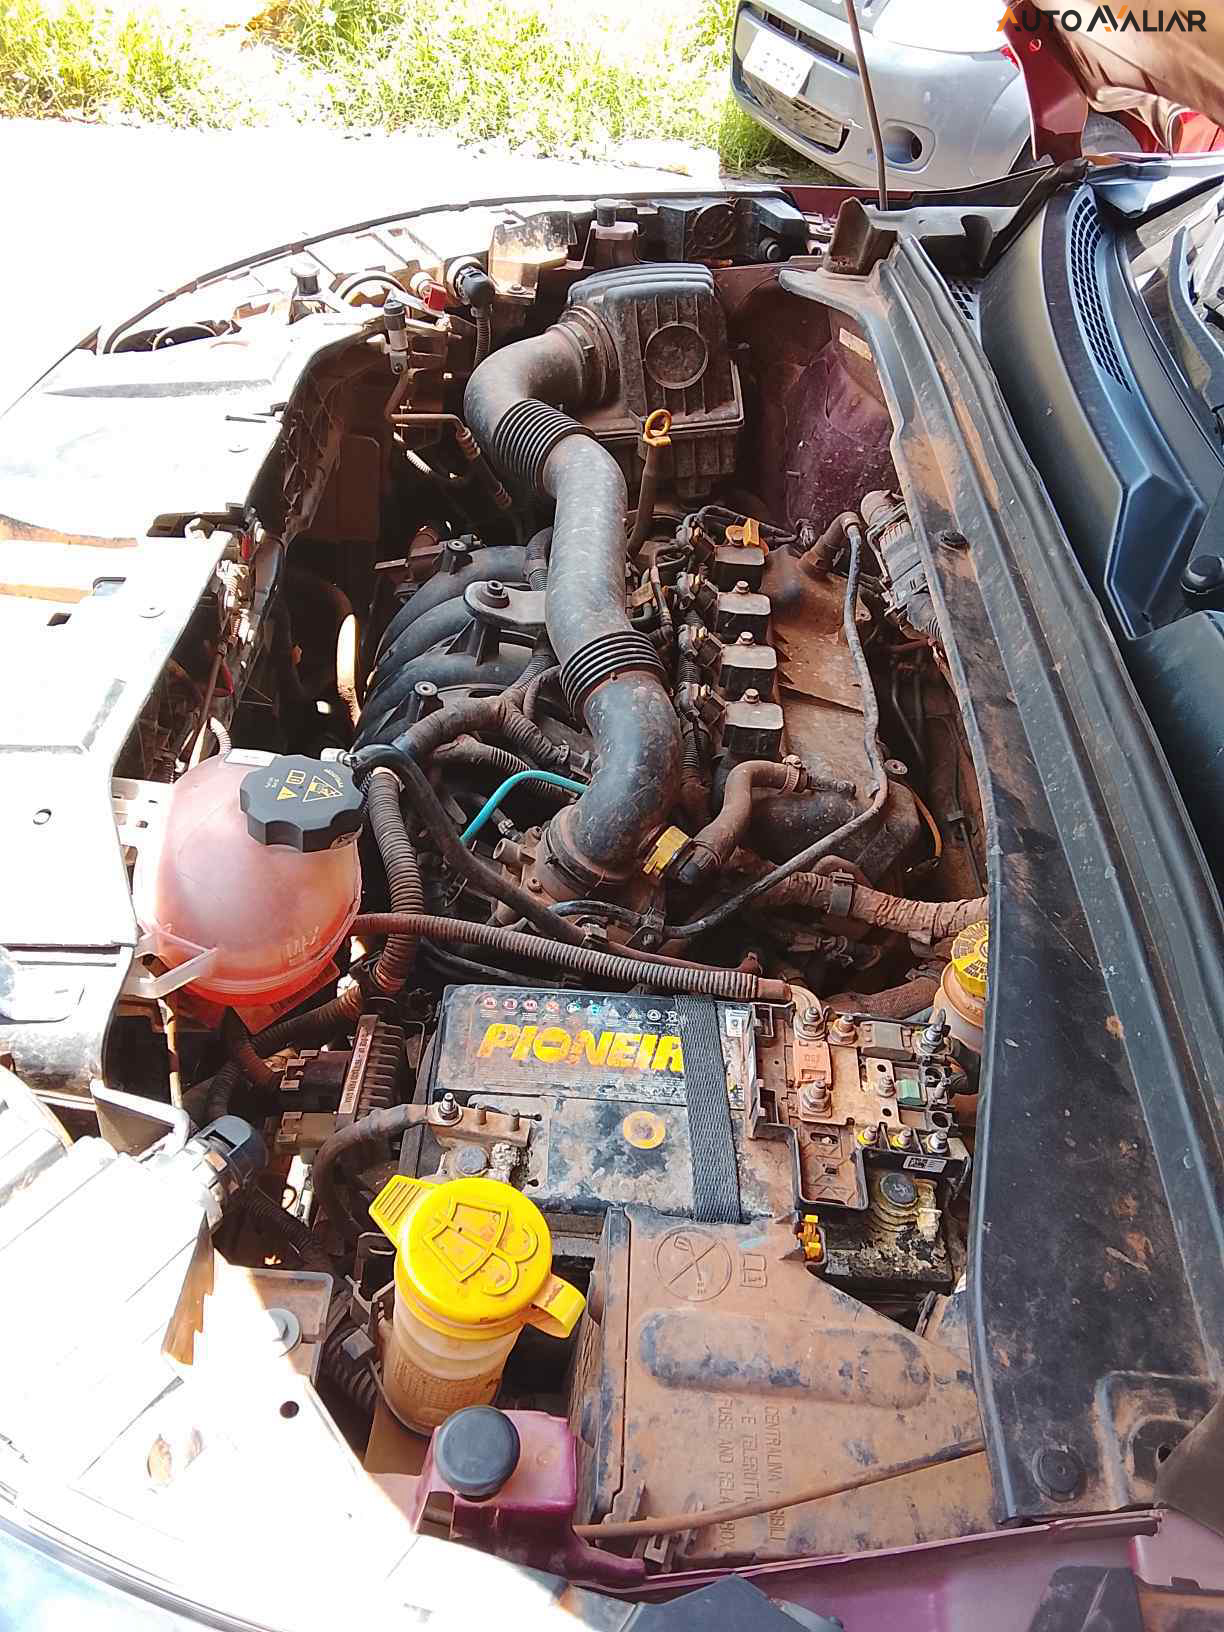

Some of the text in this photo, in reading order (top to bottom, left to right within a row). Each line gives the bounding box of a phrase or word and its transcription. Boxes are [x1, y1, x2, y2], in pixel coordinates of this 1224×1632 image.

[476, 1023, 685, 1073] PIONEIR
[718, 1399, 734, 1431] FUSE
[718, 1439, 735, 1464] AND
[718, 1471, 736, 1504] RELA
